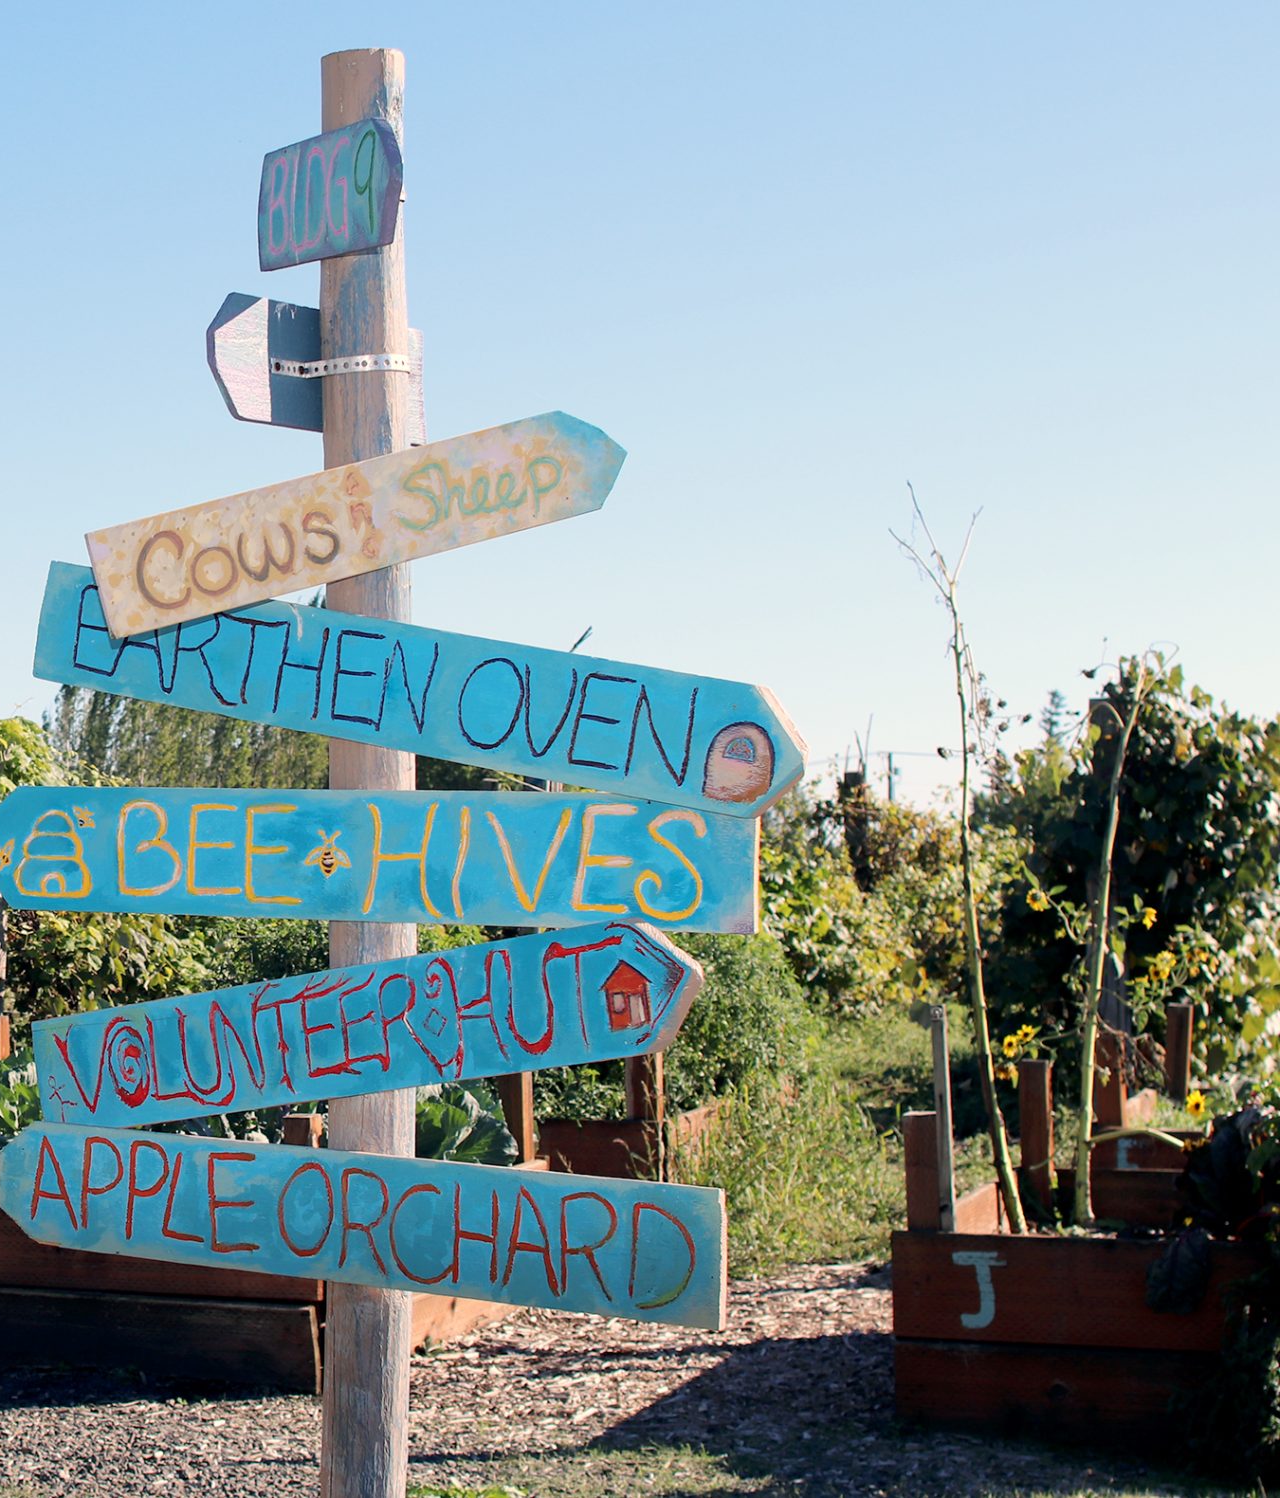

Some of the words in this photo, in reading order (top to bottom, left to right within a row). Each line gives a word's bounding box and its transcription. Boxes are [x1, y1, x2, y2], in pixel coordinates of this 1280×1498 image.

[268, 136, 350, 256] BLDG
[354, 128, 376, 236] 9
[135, 508, 340, 611] Cows
[397, 455, 564, 532] Sheep
[72, 583, 441, 737] EARTHEN
[457, 655, 700, 788] OVEN
[118, 799, 302, 906] BEE
[360, 802, 707, 922] HIVES
[51, 970, 444, 1114] VOLUNTEER
[421, 938, 624, 1080] HUT
[29, 1133, 261, 1254] APPLE
[276, 1161, 697, 1310] ORCHARD
[951, 1250, 1008, 1330] J
